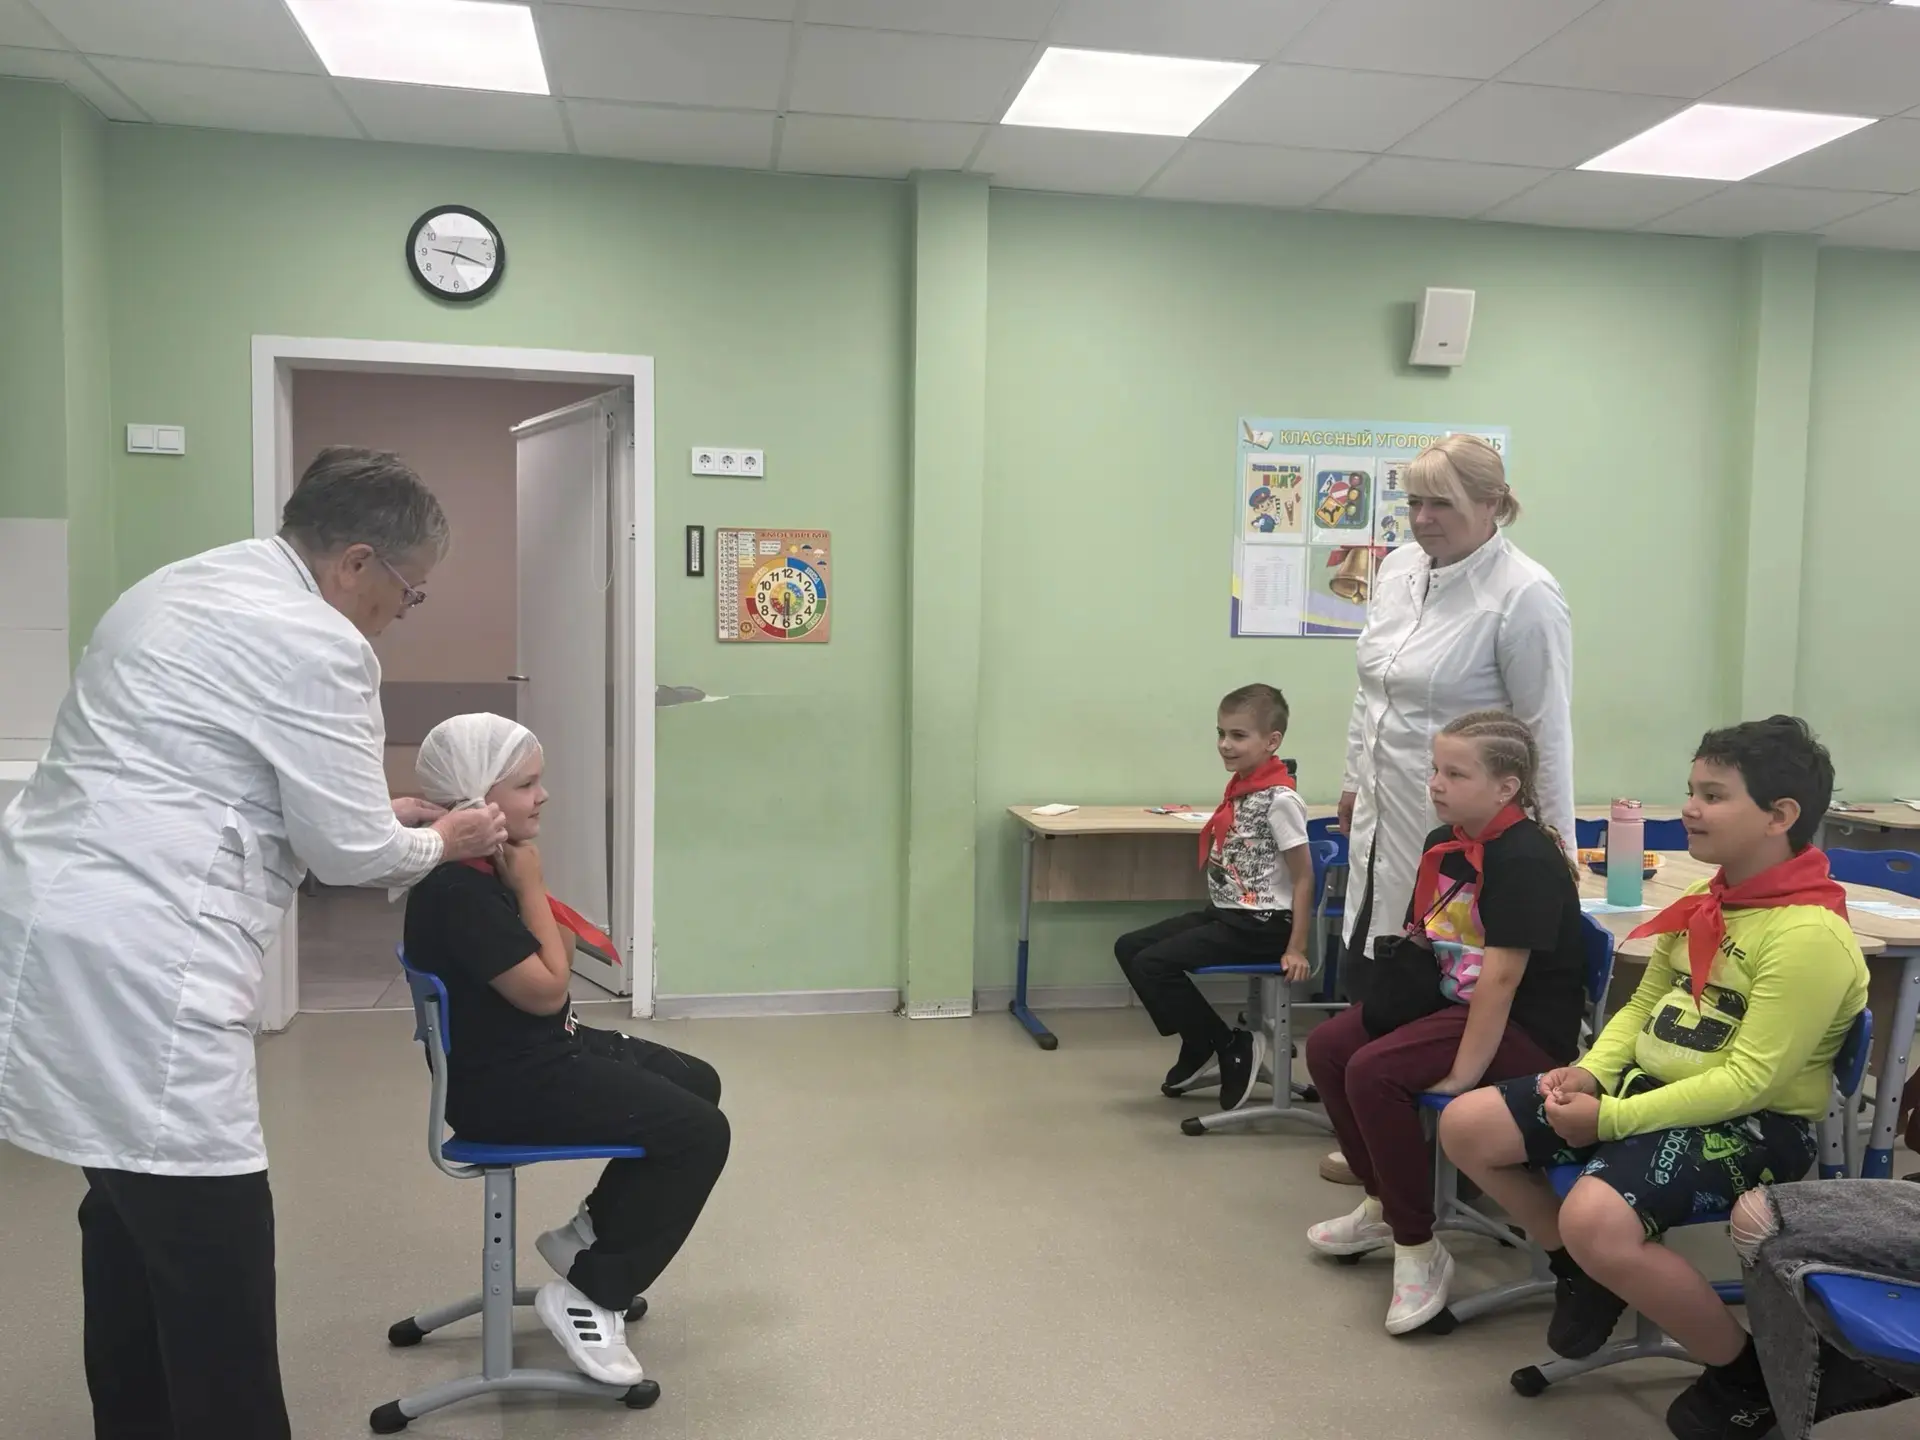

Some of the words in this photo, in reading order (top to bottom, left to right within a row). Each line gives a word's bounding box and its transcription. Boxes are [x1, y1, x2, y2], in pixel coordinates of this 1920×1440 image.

[427, 233, 437, 241] 10
[421, 247, 428, 256] 9
[485, 252, 492, 261] 3
[425, 263, 432, 272] 8
[438, 275, 445, 284] 7
[453, 280, 460, 289] 6
[1280, 429, 1372, 447] КЛАССНЫЙ
[770, 572, 779, 582] 11
[781, 568, 793, 578] 12
[796, 572, 802, 583] 1
[760, 580, 771, 591] 10
[804, 581, 812, 592] 2
[757, 592, 766, 603] 9
[807, 593, 815, 604] 3
[761, 605, 769, 616] 8
[804, 606, 812, 616] 4
[770, 614, 778, 625] 7
[783, 618, 790, 628] 6
[795, 615, 803, 625] 5
[1658, 1128, 1689, 1171] didas
